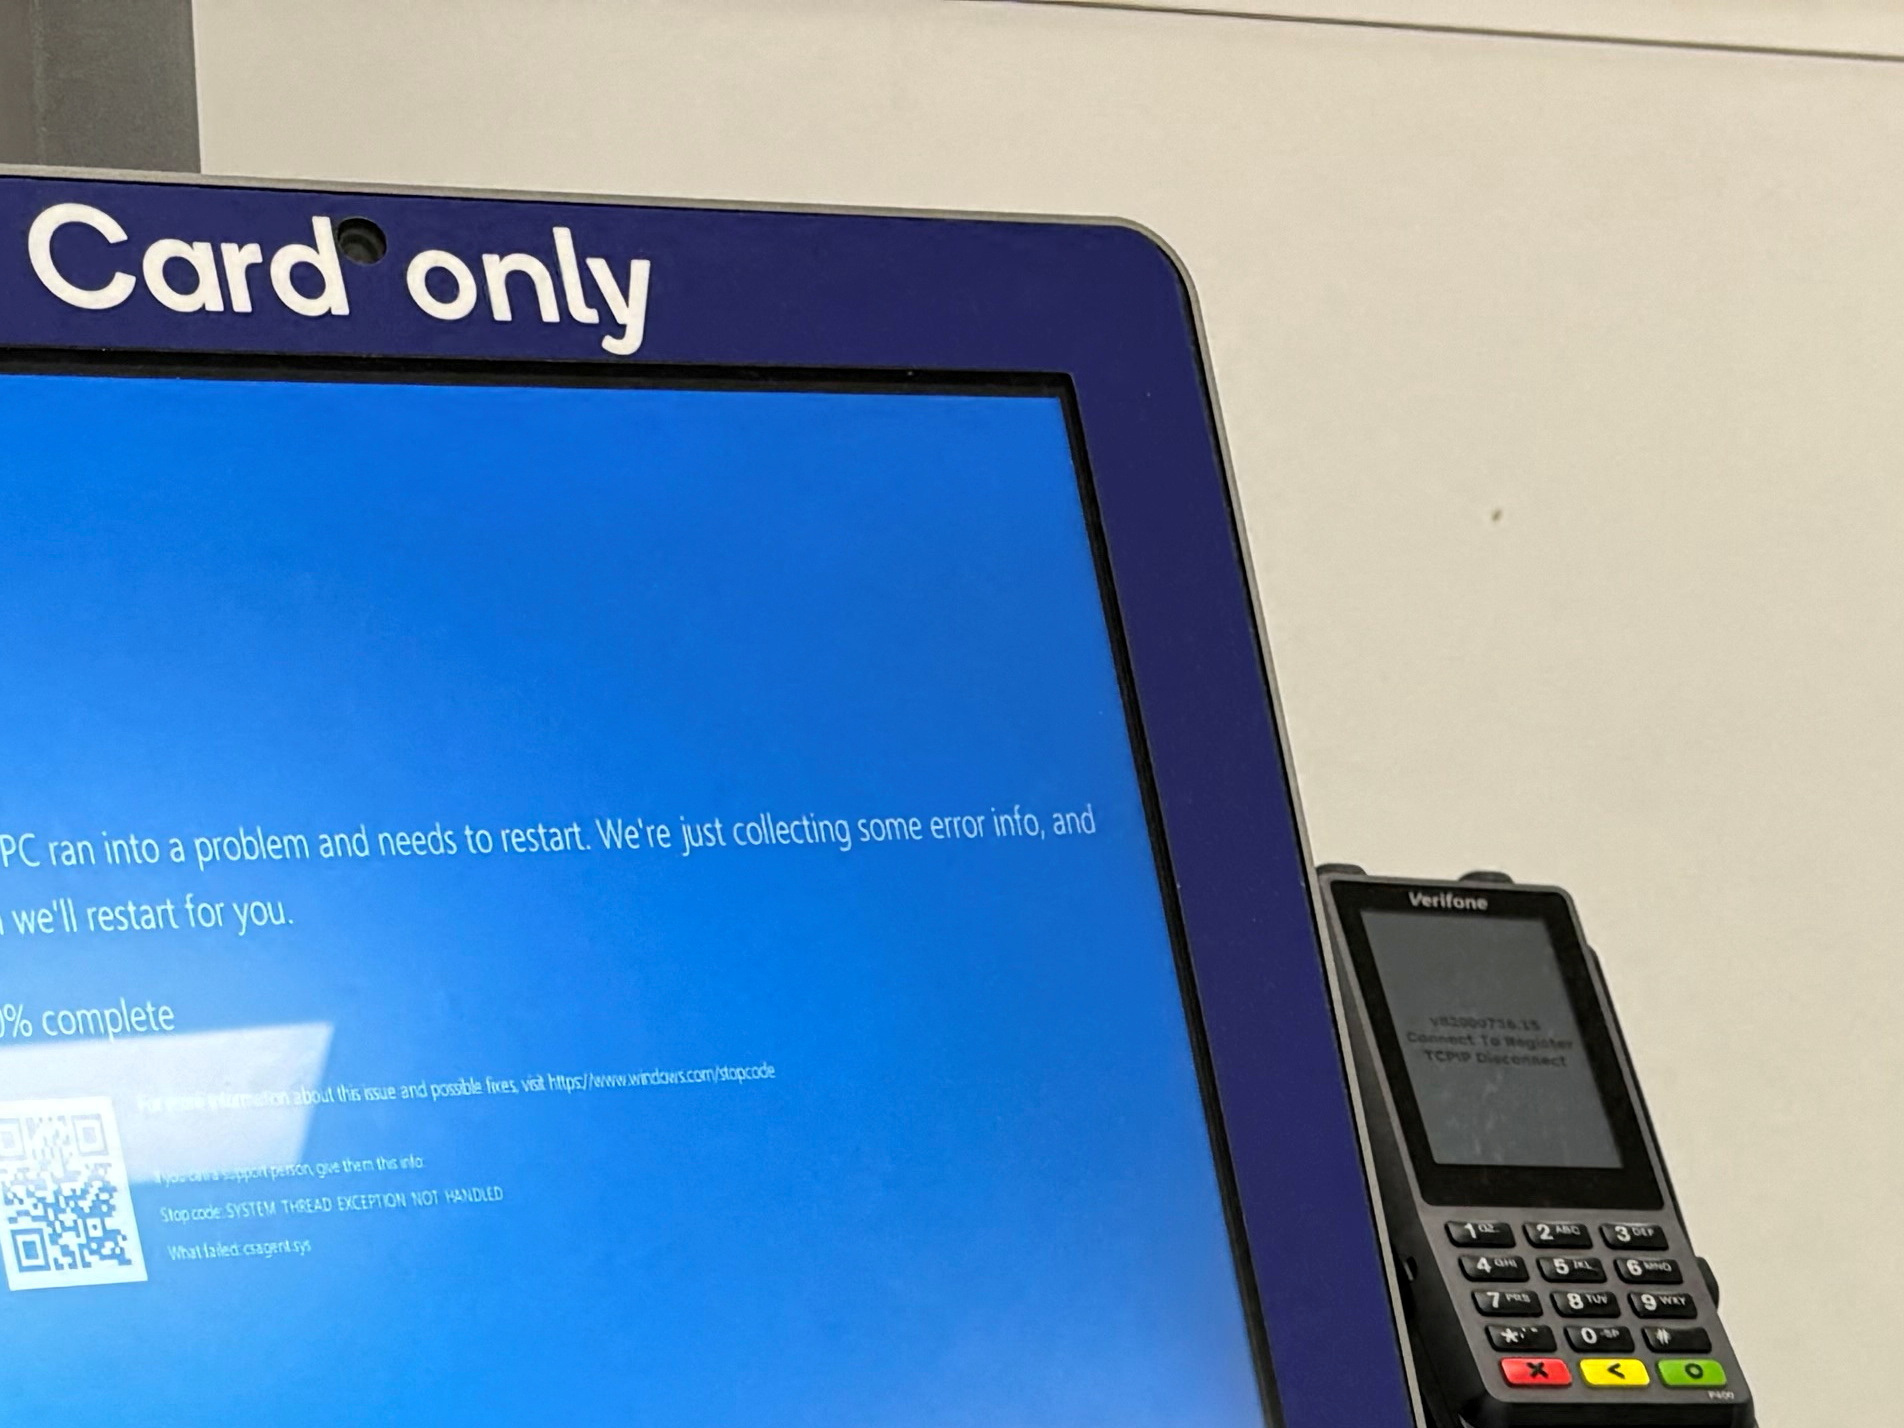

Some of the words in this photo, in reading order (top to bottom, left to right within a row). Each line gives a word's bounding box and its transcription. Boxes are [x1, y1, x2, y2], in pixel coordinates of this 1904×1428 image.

[27, 202, 352, 317] Card
[406, 226, 651, 356] only
[0, 832, 42, 869] PC
[48, 839, 97, 867] ran
[102, 830, 161, 865] into
[168, 837, 186, 864] a
[194, 826, 311, 872] problem
[318, 823, 371, 858] and
[377, 822, 458, 856] needs
[464, 826, 495, 855] to
[501, 817, 592, 854] restart.
[596, 815, 672, 851] We're
[679, 813, 728, 857] just
[731, 812, 853, 852] collecting
[856, 815, 924, 844] some
[928, 811, 986, 840] error
[992, 805, 1046, 841] info,
[1051, 803, 1097, 836] and
[1407, 890, 1489, 911] Verifone
[12, 896, 79, 934] we'll
[86, 896, 180, 932] restart
[184, 892, 226, 929] for
[231, 898, 295, 936] you.
[41, 996, 176, 1042] complete
[1406, 1031, 1476, 1046] Connect
[1480, 1034, 1501, 1047] To
[1504, 1035, 1574, 1051] Register
[1476, 1051, 1568, 1067] Disconnect
[293, 1085, 335, 1105] about
[337, 1083, 361, 1102] this
[364, 1083, 397, 1101] issue
[400, 1079, 428, 1100] and
[431, 1076, 483, 1101] possible
[521, 1073, 546, 1093] visit
[317, 1160, 341, 1179] give
[342, 1157, 375, 1173] them
[376, 1155, 398, 1171] this
[159, 1206, 190, 1224] Stop
[1464, 1223, 1477, 1239] 1
[1536, 1223, 1554, 1240] 2
[1614, 1225, 1631, 1242] 3
[166, 1243, 202, 1260] What
[1476, 1257, 1492, 1273] 4
[1553, 1258, 1570, 1275] 5
[1626, 1259, 1643, 1276] 6
[1486, 1291, 1500, 1309] 7
[1566, 1292, 1584, 1310] 8
[1640, 1293, 1657, 1311] 9
[1581, 1327, 1598, 1344] 0
